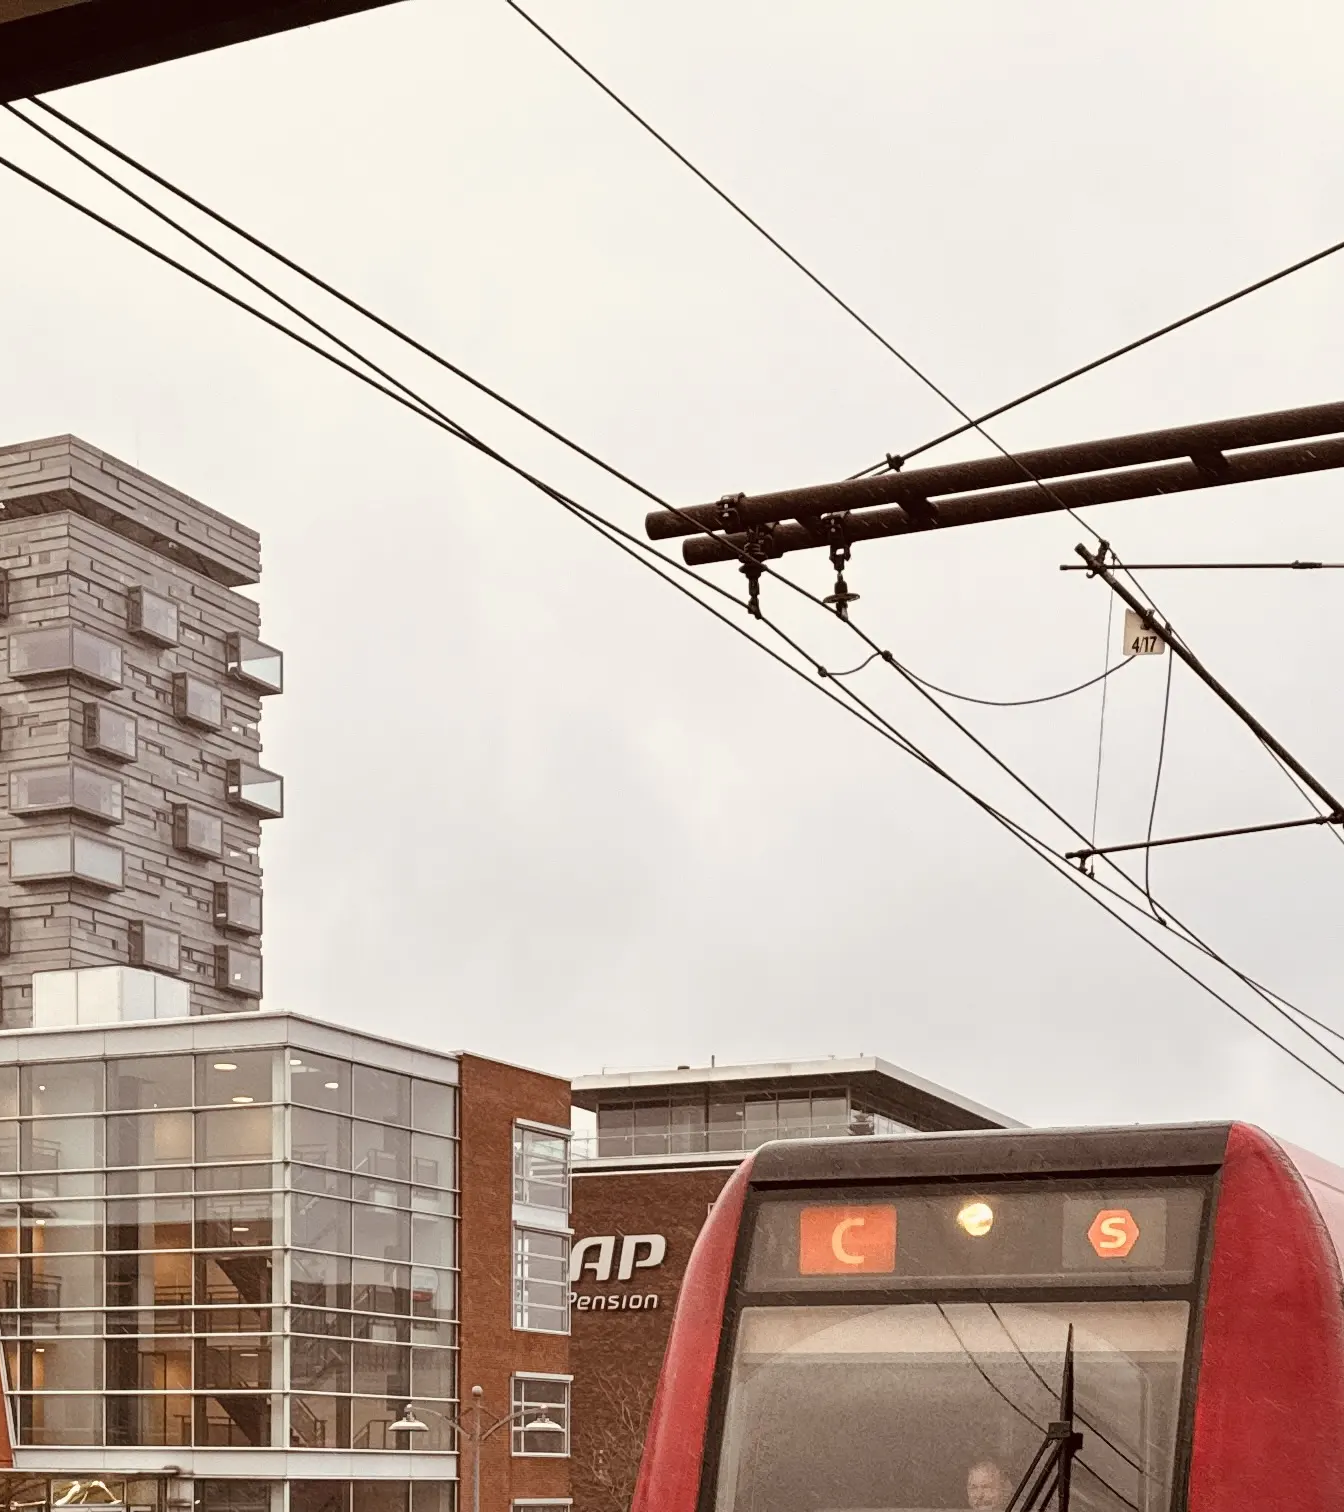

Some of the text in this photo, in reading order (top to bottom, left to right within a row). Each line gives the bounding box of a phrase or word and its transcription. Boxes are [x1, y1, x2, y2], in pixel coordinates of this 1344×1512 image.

[1131, 635, 1158, 653] 4/17
[831, 1217, 865, 1265] C
[1099, 1216, 1127, 1249] S
[570, 1233, 666, 1282] AP
[567, 1291, 658, 1311] Pension
